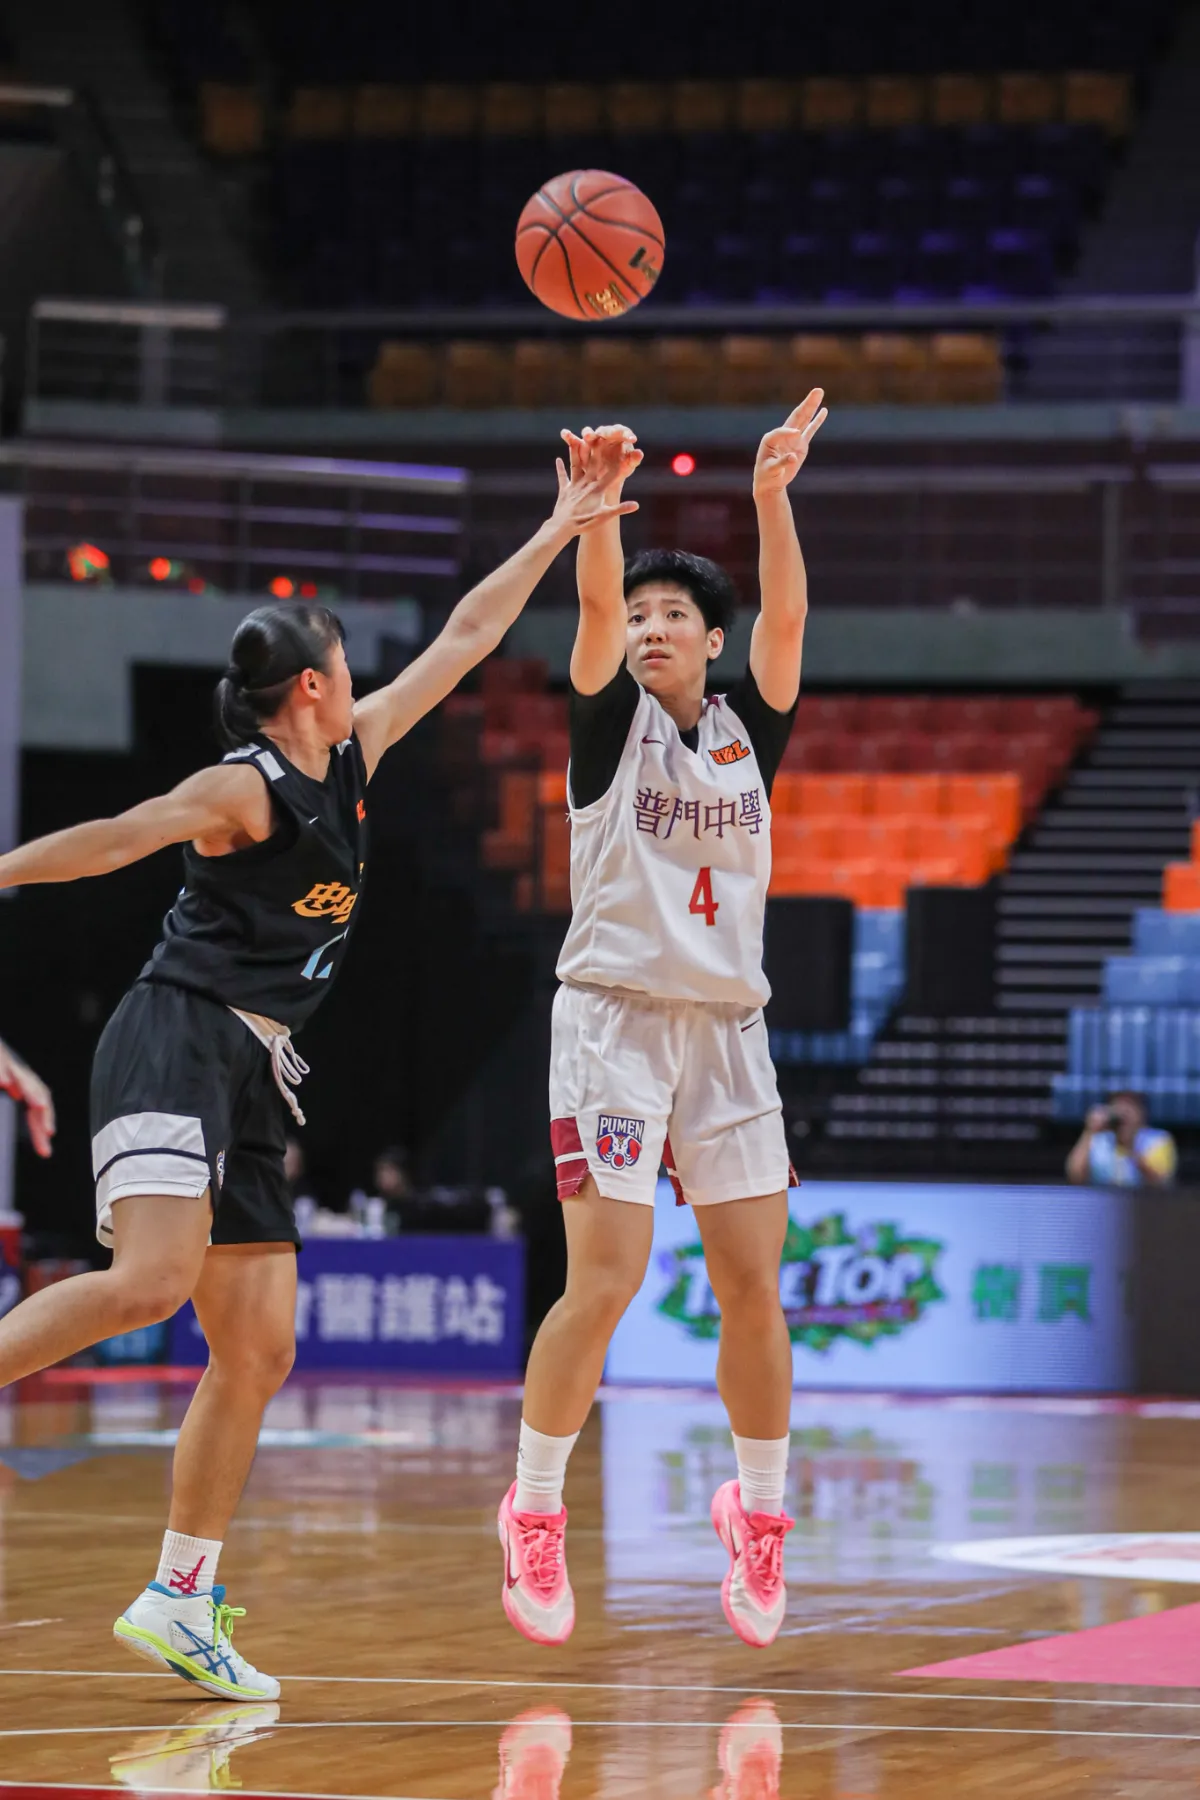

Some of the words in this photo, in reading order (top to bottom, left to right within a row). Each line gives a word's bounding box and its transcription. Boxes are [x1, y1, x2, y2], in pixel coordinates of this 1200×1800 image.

[708, 739, 751, 766] HBL
[633, 787, 763, 841] 普門中學
[688, 866, 719, 926] 4
[599, 1116, 644, 1140] PUMEN
[296, 1274, 506, 1343] 醫護站
